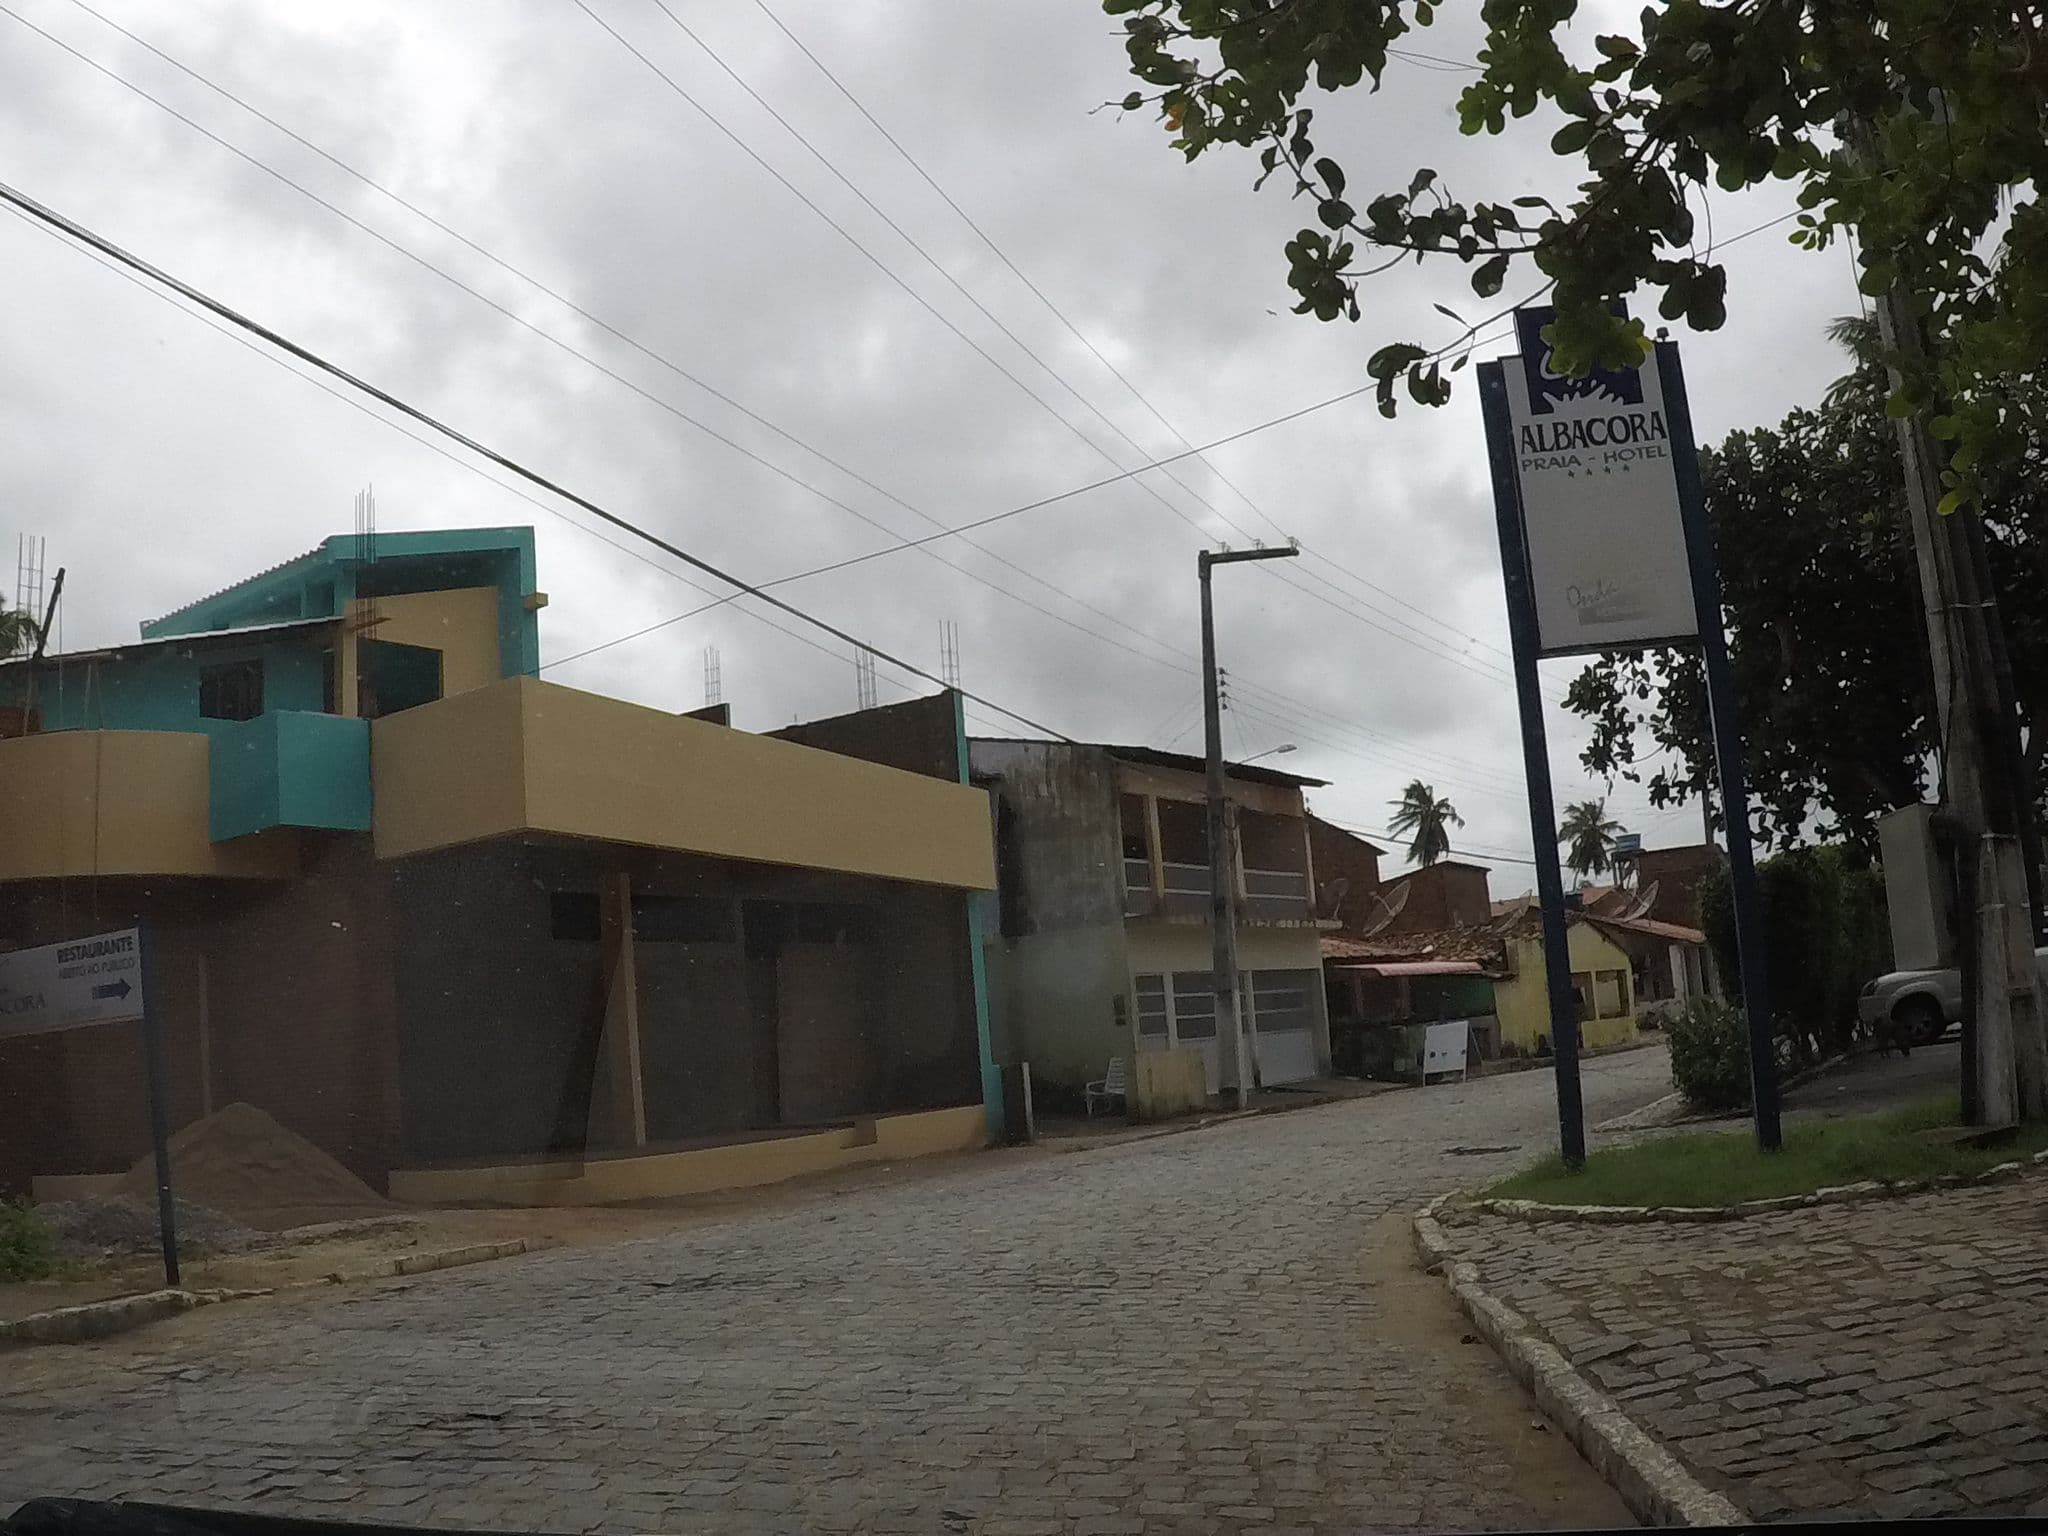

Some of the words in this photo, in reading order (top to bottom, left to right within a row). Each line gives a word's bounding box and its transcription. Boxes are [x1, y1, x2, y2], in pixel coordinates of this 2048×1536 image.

[1521, 411, 1668, 454] ALBACORA
[1521, 454, 1582, 472] PRAIA
[1603, 445, 1667, 464] HOTEL
[57, 936, 134, 964] RESTAURANTE
